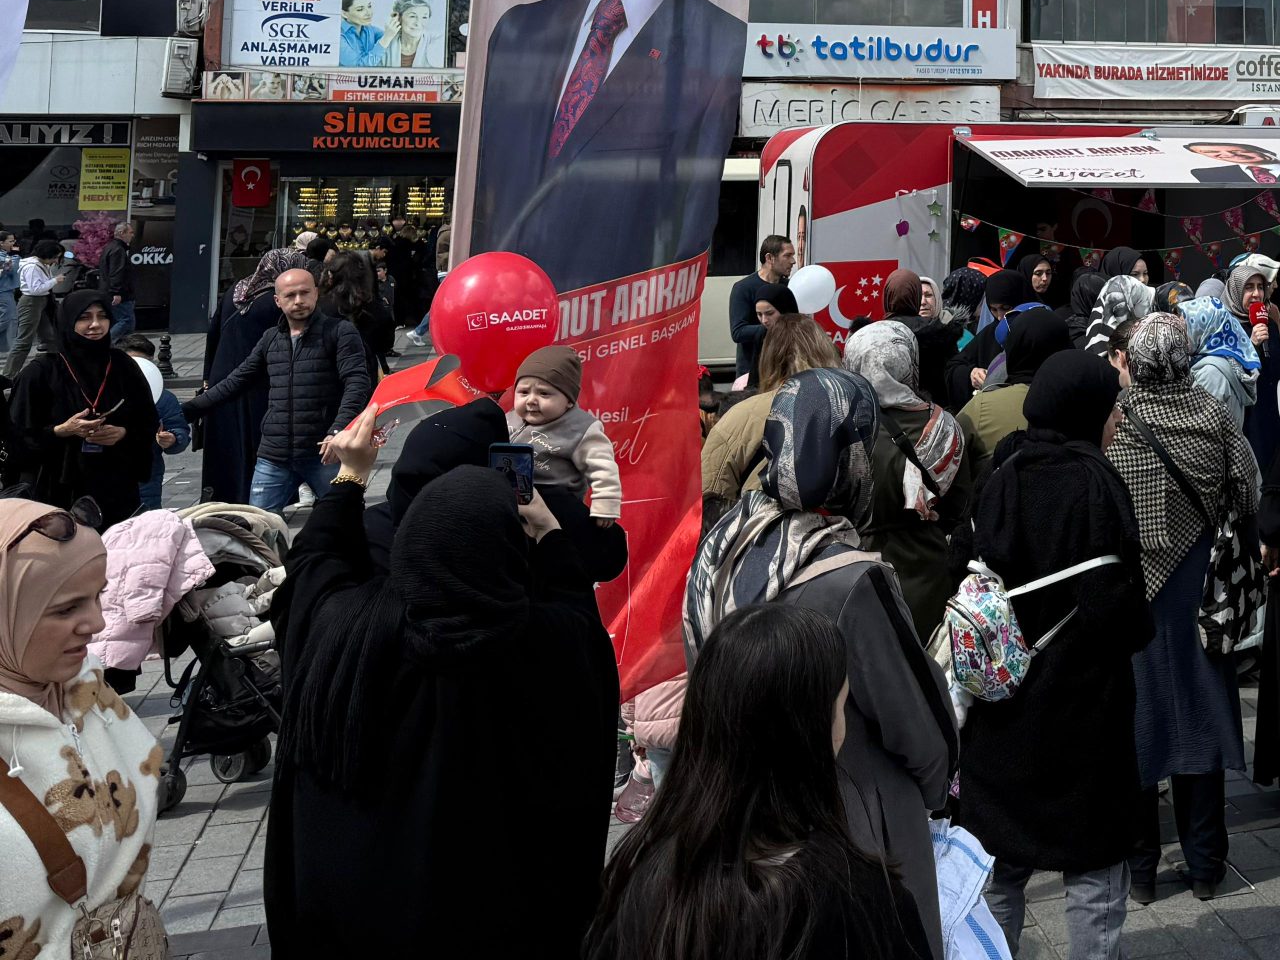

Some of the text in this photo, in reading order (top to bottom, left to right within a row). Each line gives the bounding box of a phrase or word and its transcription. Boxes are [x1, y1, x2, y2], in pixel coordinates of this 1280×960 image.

[262, 1, 314, 12] VERİLİR
[268, 22, 310, 39] SGK
[240, 42, 331, 55] ANLAŞMAMIZ
[811, 35, 979, 62] tatilbudur
[260, 55, 310, 67] VARDIR
[1036, 62, 1229, 81] YAKINDA BURADA HİZMETİNİZDE
[357, 75, 415, 89] UZMAN
[323, 106, 432, 134] SİMGE
[312, 136, 440, 149] KUYUMCULUK
[989, 147, 1084, 158] MAHMUT
[1086, 145, 1160, 155] ARIKAN
[83, 192, 124, 202] HEDİYE
[130, 253, 174, 265] OKKA
[611, 261, 702, 326] ARIKAN
[489, 308, 548, 325] SAADET
[596, 334, 647, 358] GENEL
[651, 310, 696, 343] BAŞKANI
